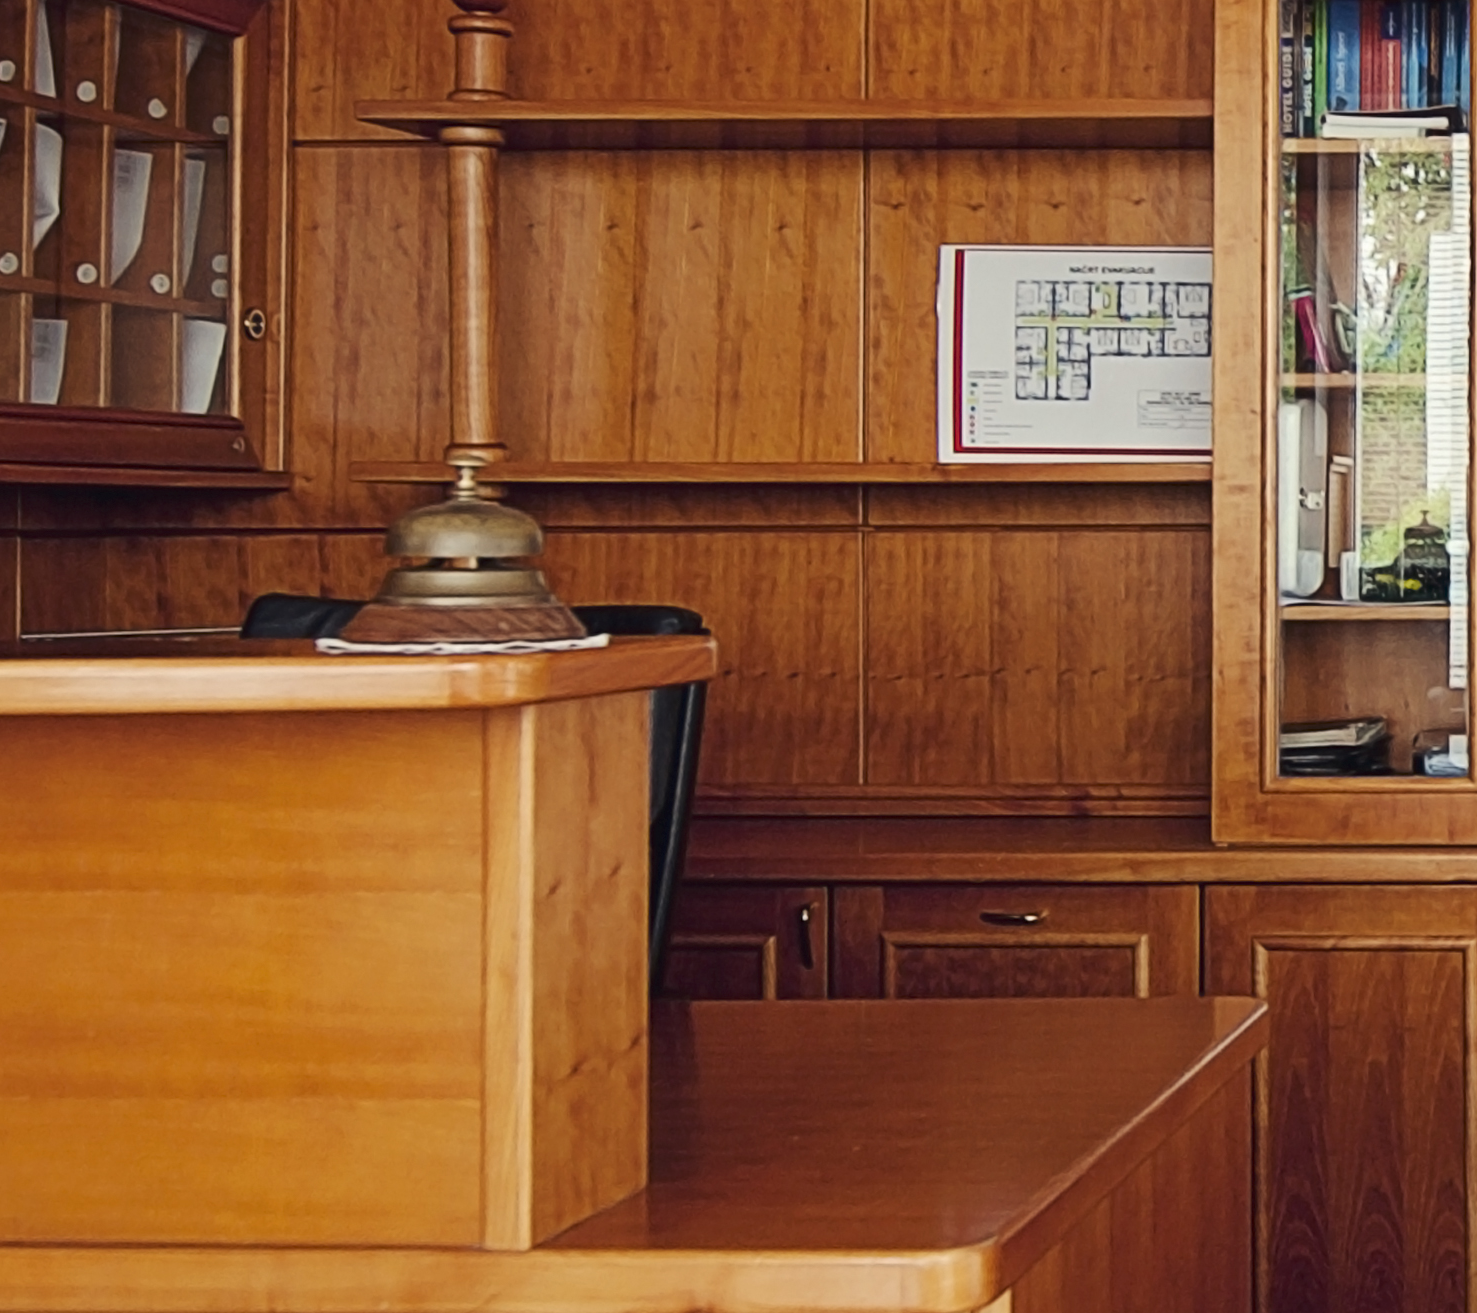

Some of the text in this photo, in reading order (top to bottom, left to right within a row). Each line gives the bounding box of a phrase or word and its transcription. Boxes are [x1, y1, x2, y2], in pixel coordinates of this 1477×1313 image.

[1281, 45, 1293, 133] HOTEL GUIDE
[1303, 46, 1313, 118] HOTEL GUIDE
